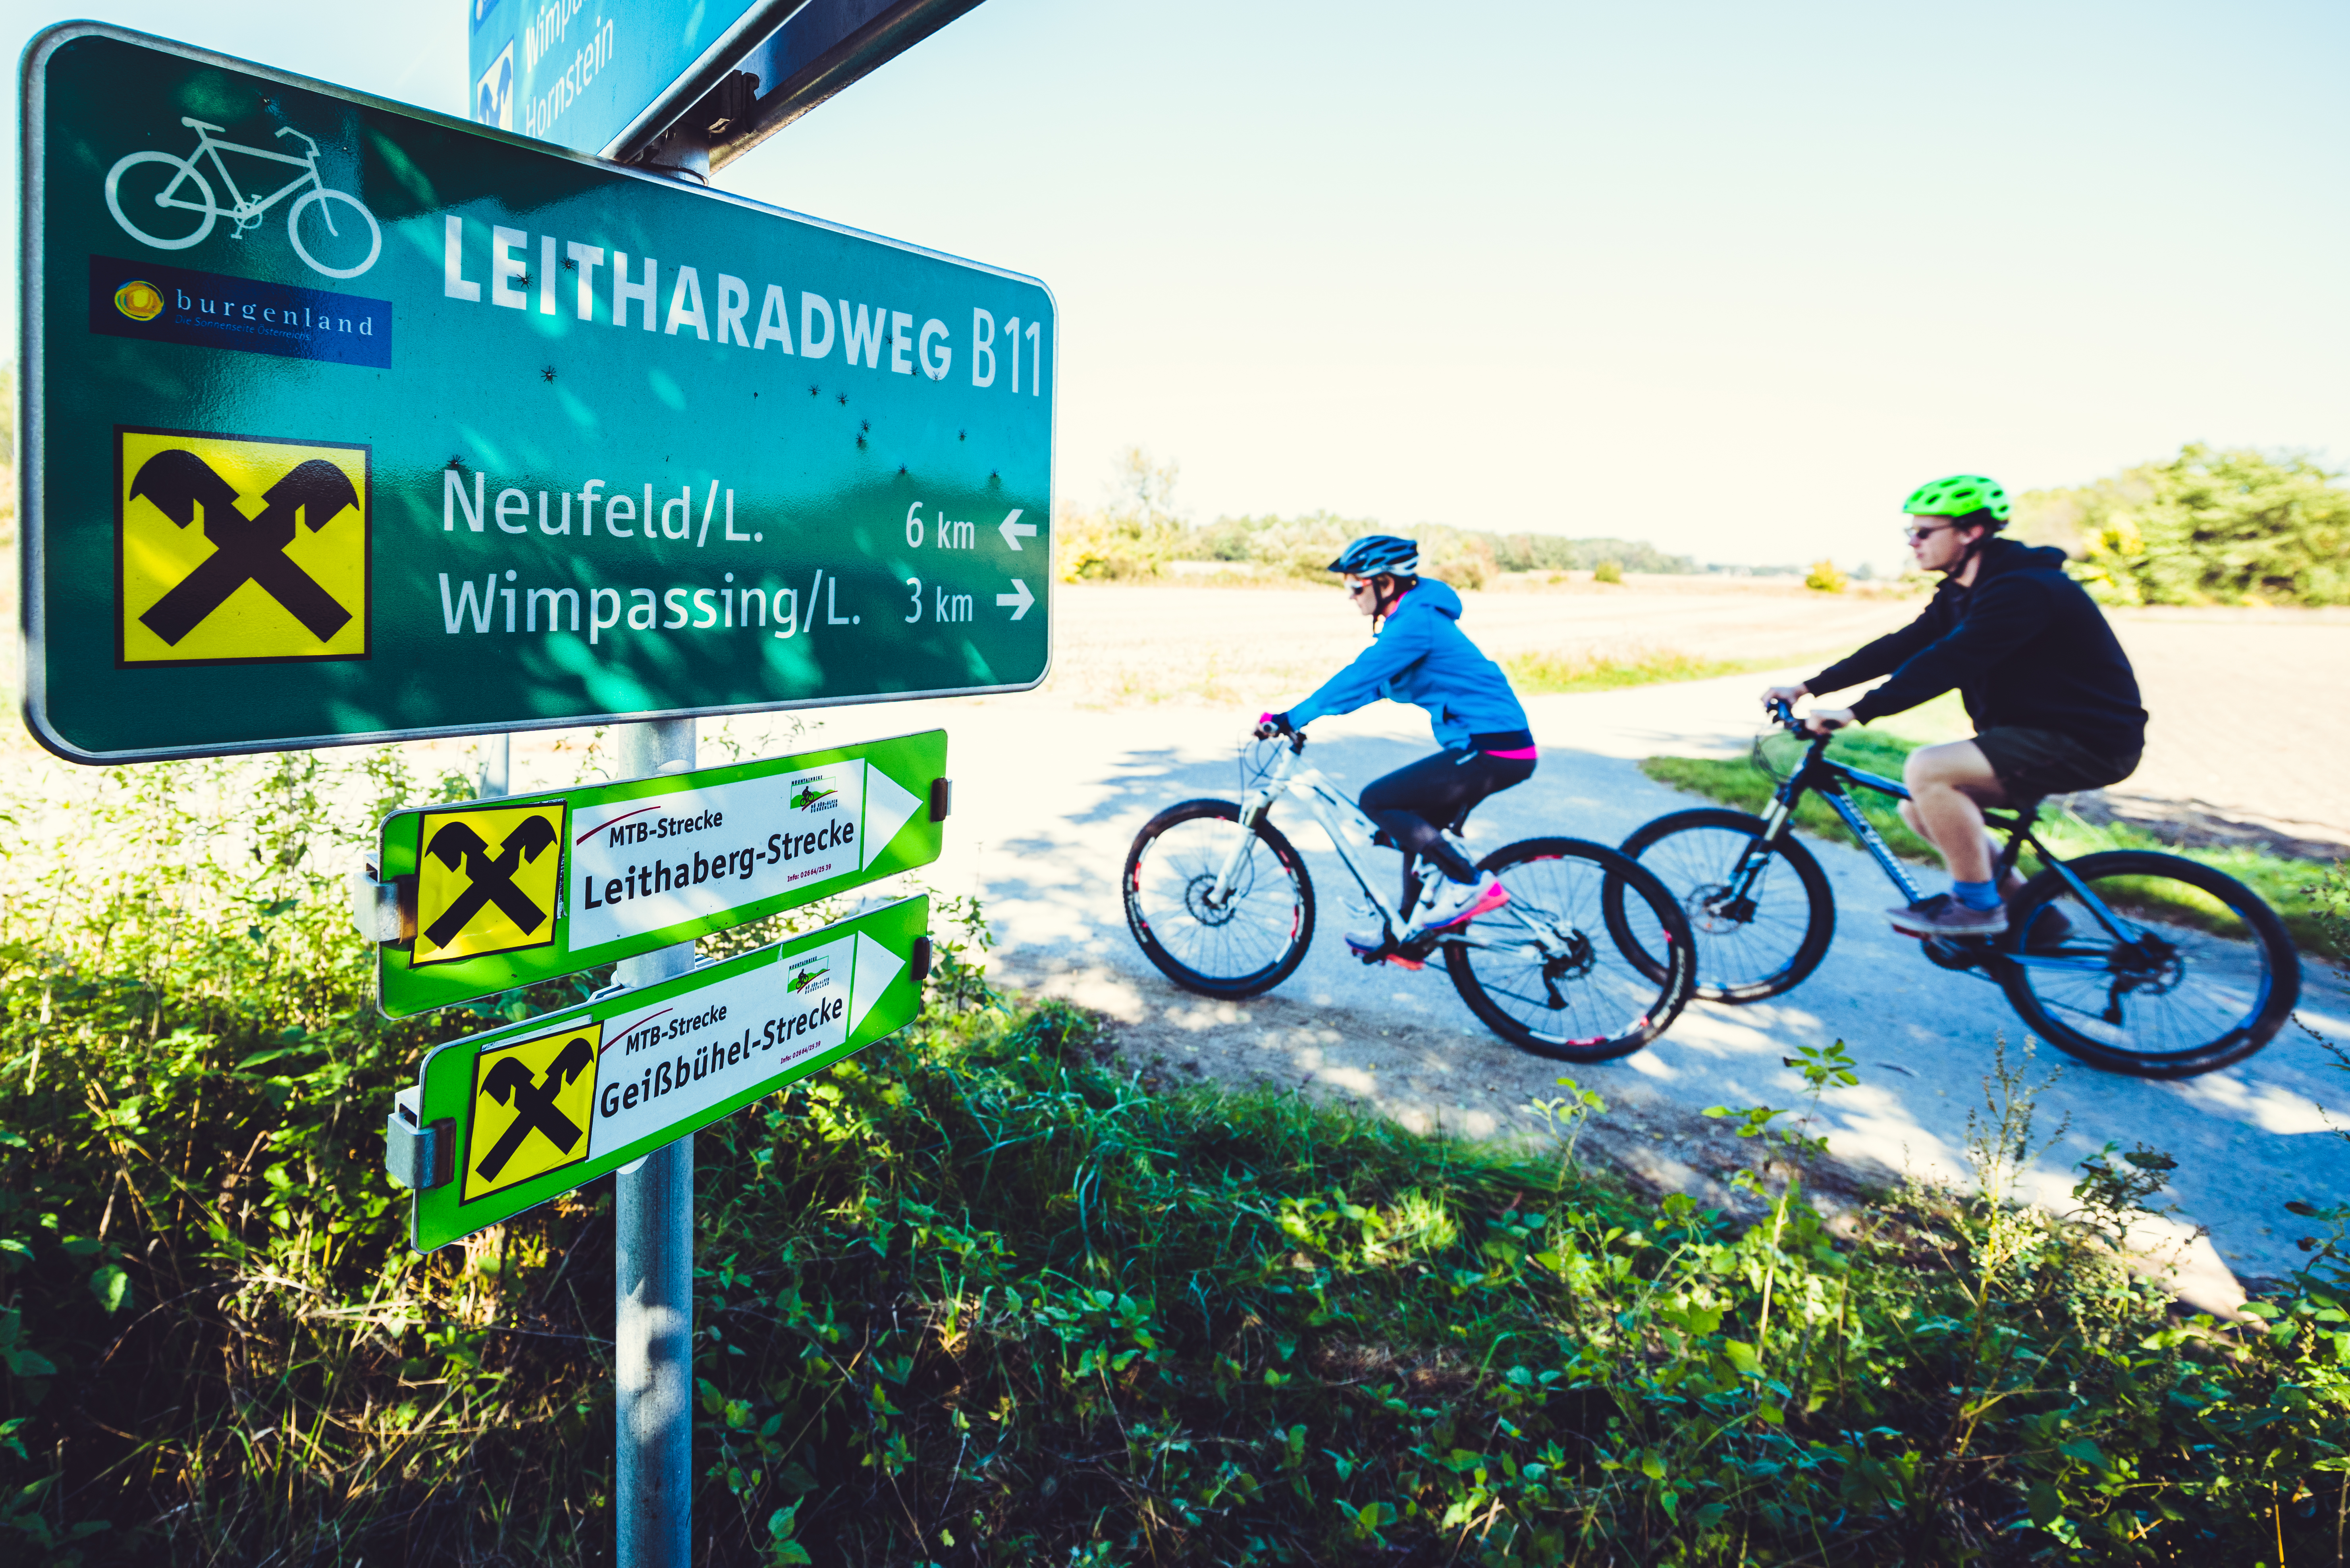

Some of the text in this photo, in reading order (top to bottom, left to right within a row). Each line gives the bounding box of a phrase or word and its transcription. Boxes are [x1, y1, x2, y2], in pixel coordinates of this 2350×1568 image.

[526, 15, 613, 138] Hornstein
[175, 315, 191, 325] Die
[195, 317, 254, 333] Sonnenseite
[176, 289, 373, 335] burgenland
[445, 215, 1040, 396] LEITHARADWEG B11
[443, 470, 974, 549] Neufeld/L. 6 km
[439, 569, 972, 644] Wimpassing/L. 3 km
[791, 775, 822, 785] MOUNTAINBIKE
[610, 810, 723, 848] MTB-Strecke
[811, 803, 837, 813] BURGENLAND
[585, 819, 854, 910] Leithaberg-Strecke
[787, 874, 799, 882] Info:
[625, 1005, 727, 1056] MTB-Strecke
[601, 996, 842, 1118] Geißbühel-Strecke
[781, 1056, 791, 1064] Info:
